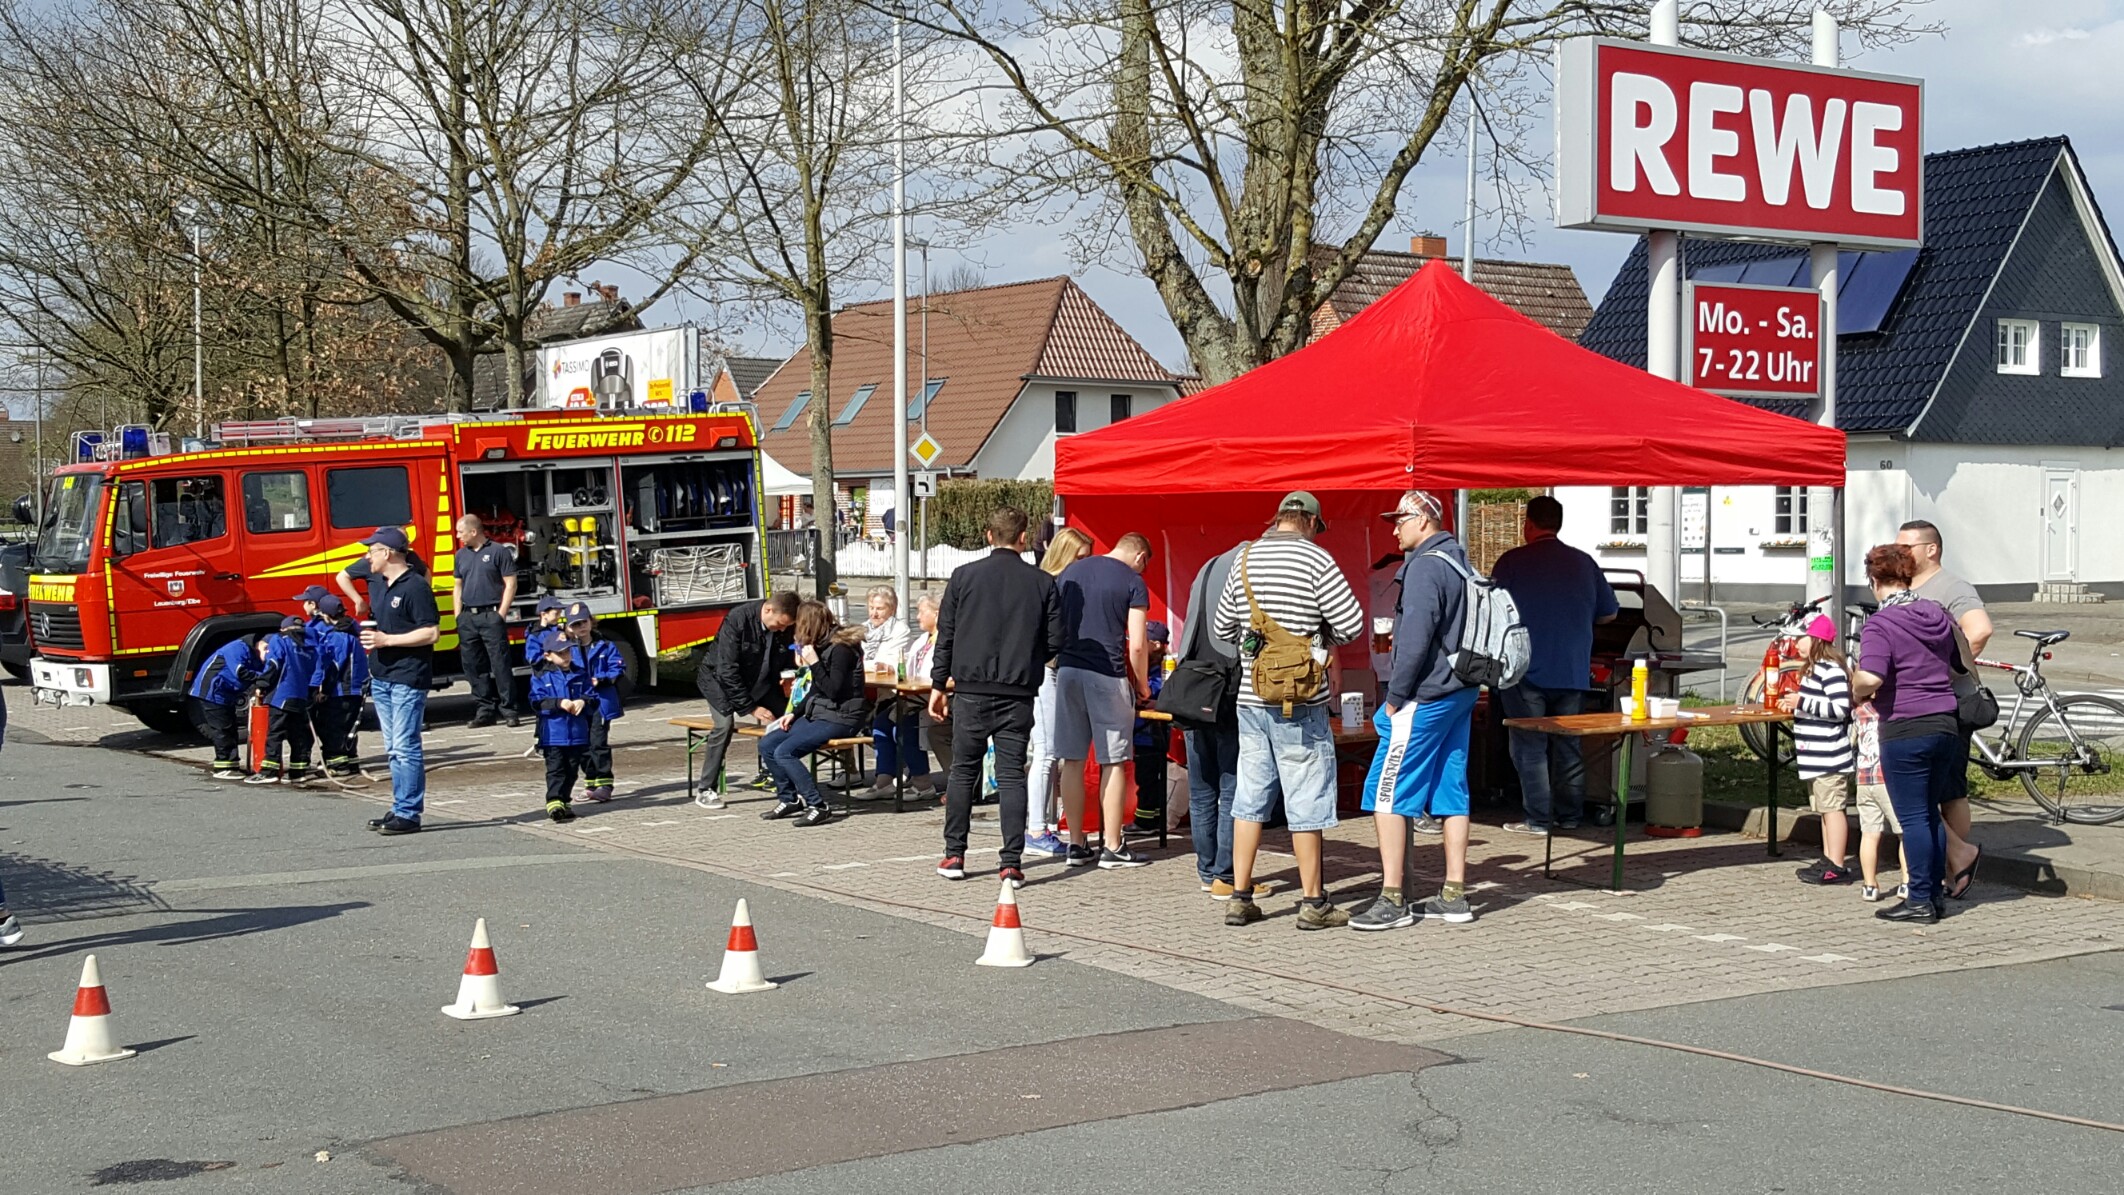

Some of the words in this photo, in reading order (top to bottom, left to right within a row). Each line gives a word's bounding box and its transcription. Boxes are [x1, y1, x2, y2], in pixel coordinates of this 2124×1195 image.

[1611, 71, 1906, 216] REWE
[1699, 301, 1750, 335] Mo.
[1776, 306, 1814, 339] Sa.
[561, 360, 589, 374] TASSIMO
[1767, 350, 1813, 383] Uhr
[527, 423, 646, 451] FEUERWEHR
[665, 424, 697, 443] 112
[1880, 460, 1893, 470] 60
